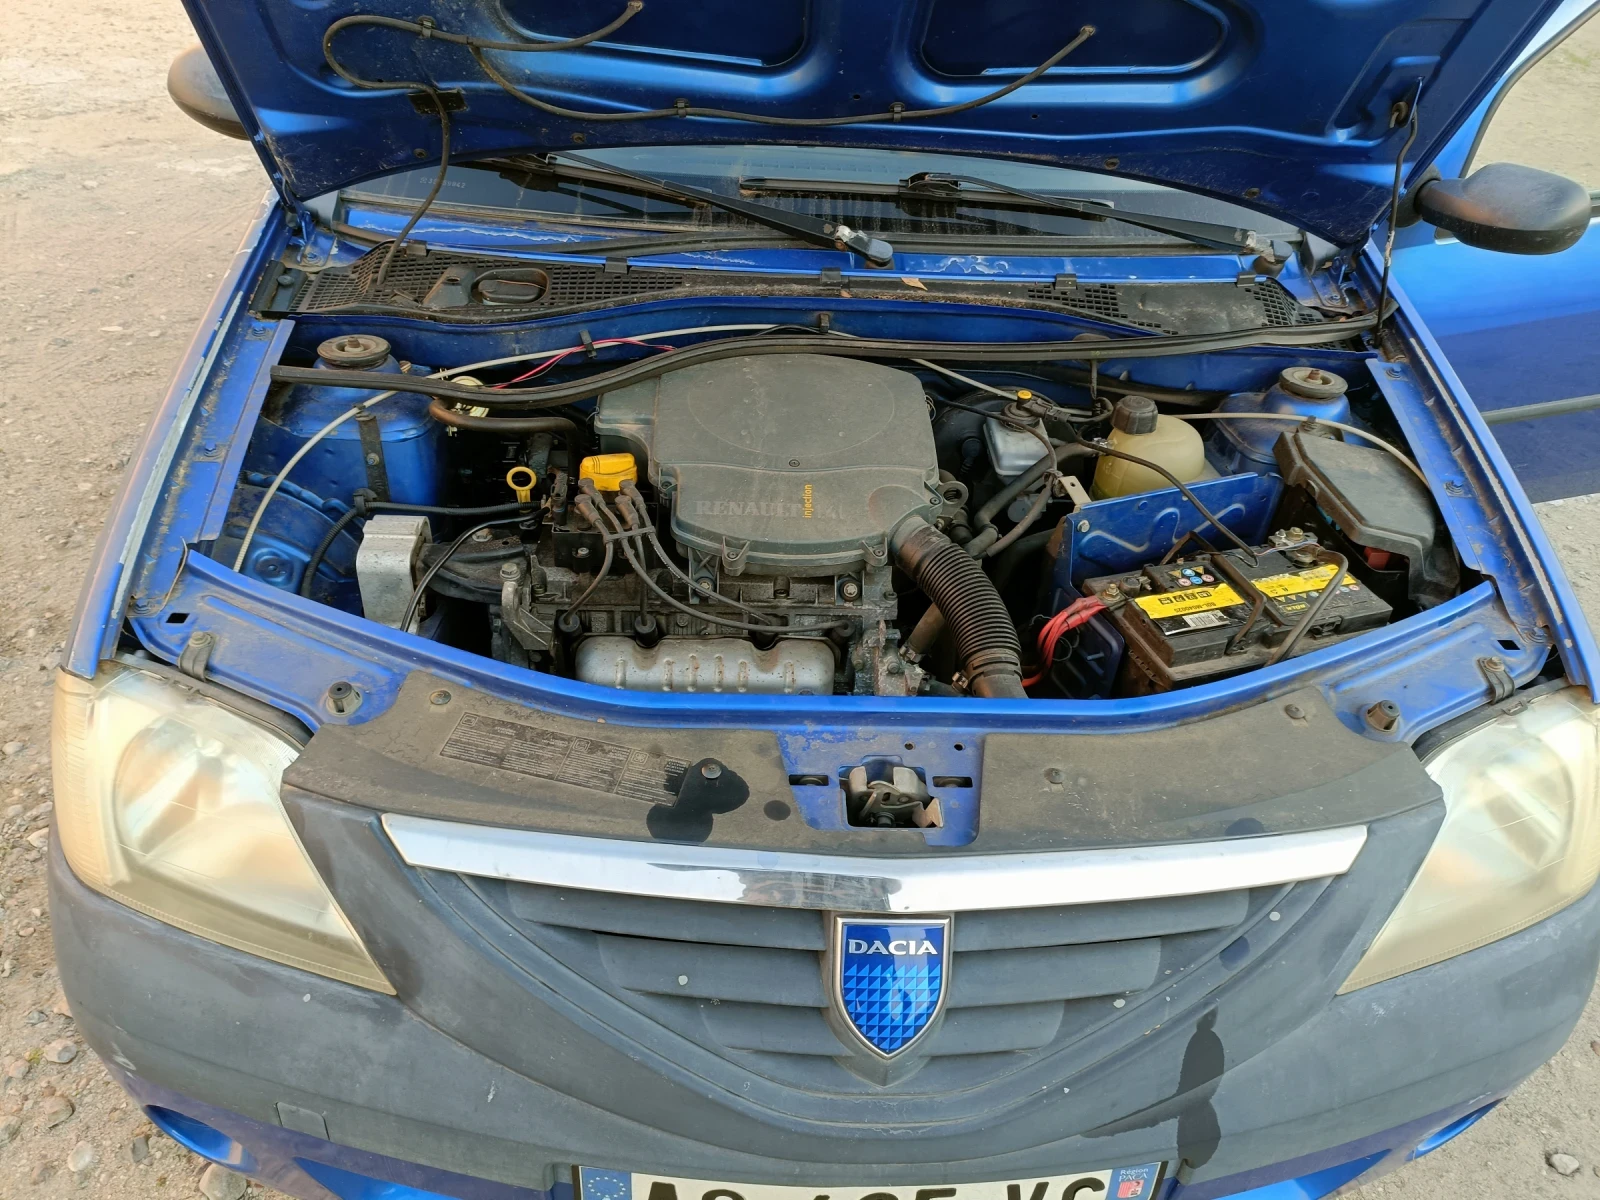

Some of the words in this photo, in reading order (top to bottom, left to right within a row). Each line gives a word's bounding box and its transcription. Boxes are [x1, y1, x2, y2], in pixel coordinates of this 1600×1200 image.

[693, 500, 801, 518] RENAULT
[802, 484, 813, 518] injection
[848, 938, 938, 955] DACIA
[1118, 1173, 1147, 1182] PACA
